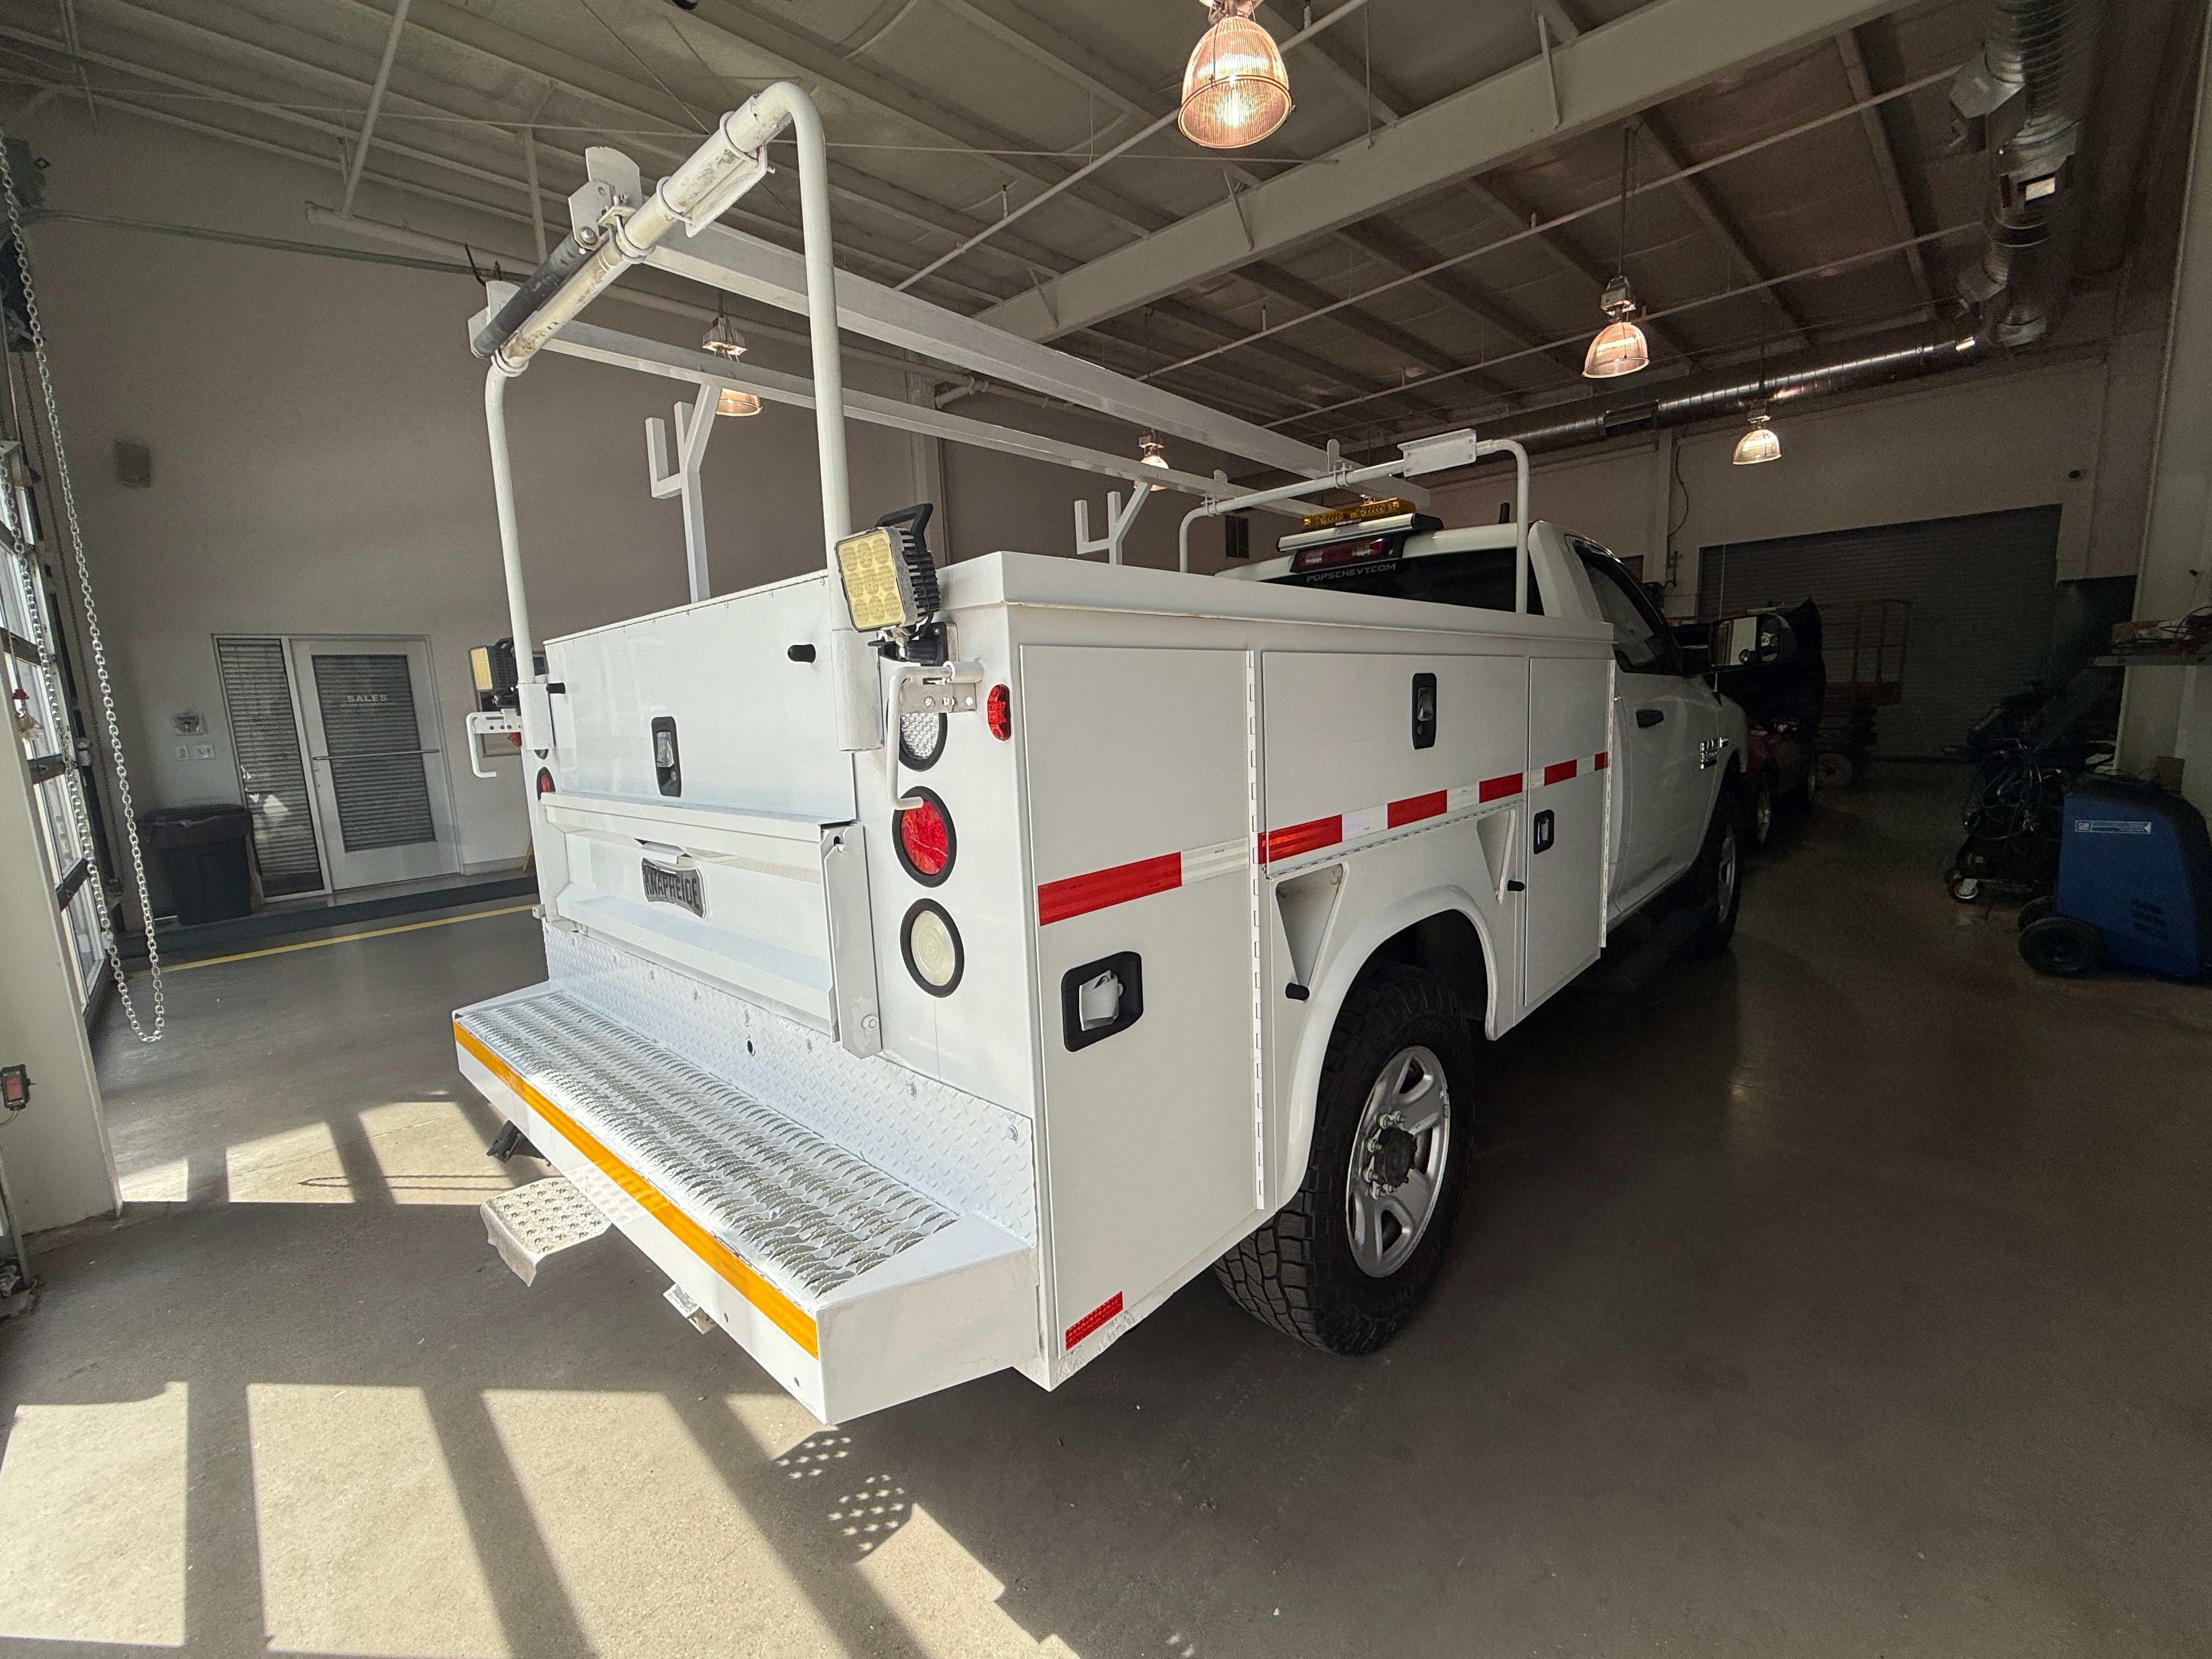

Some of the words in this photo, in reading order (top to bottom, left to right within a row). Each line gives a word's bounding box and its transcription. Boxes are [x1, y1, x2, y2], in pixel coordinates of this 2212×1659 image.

[1306, 562, 1396, 583] POPSCHEVY.COM
[347, 693, 388, 703] SALES
[645, 865, 701, 911] KNAPHEIDE
